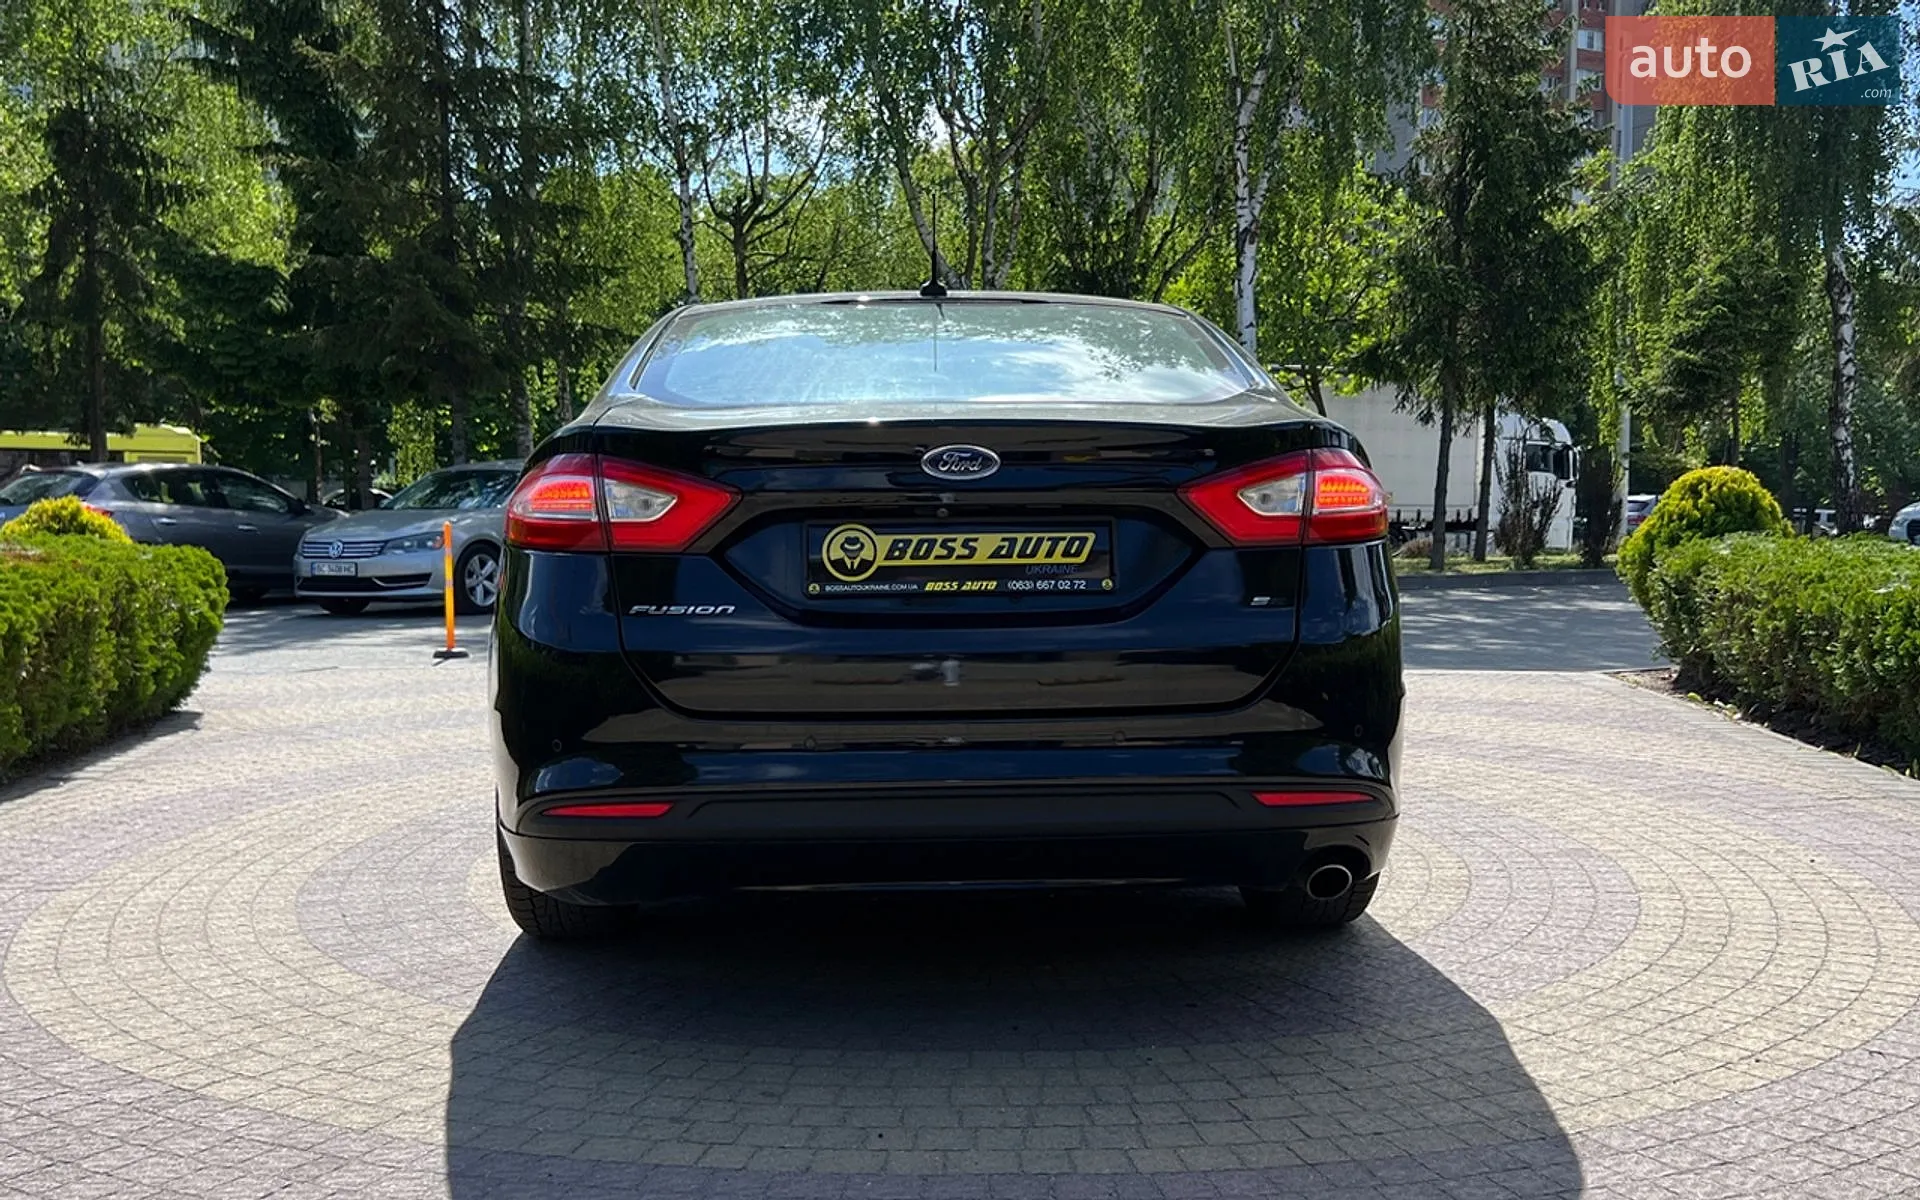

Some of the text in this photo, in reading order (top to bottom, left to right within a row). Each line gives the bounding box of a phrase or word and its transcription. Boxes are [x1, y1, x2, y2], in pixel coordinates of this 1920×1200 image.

[938, 451, 983, 472] Ford
[883, 536, 1089, 560] BOSS AUTO
[1025, 564, 1079, 574] UKRAINE
[924, 580, 997, 591] BOSS AUTO
[1007, 580, 1087, 590] (063) 667 02 72
[628, 604, 736, 615] FUSION
